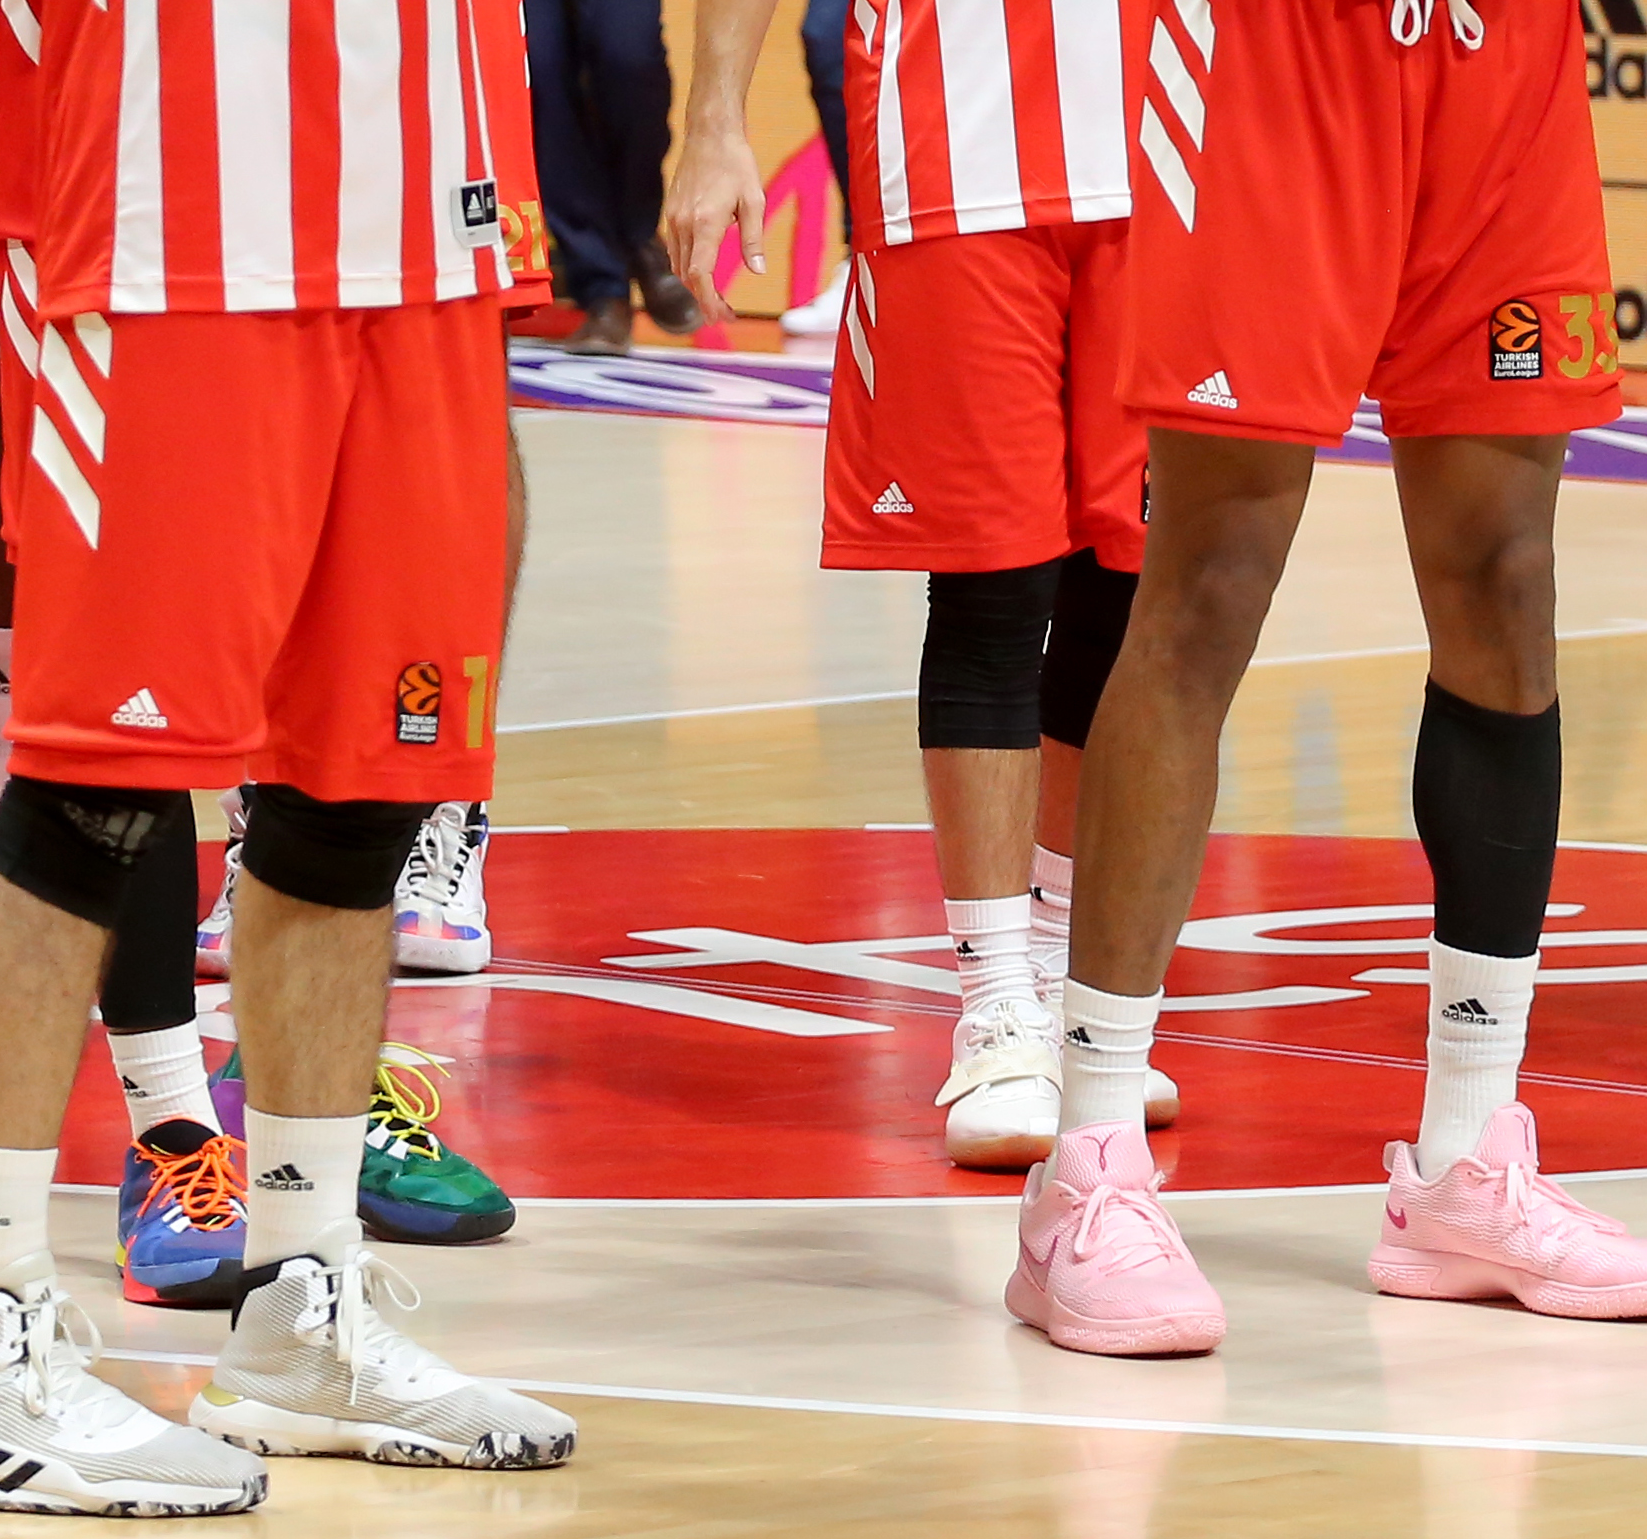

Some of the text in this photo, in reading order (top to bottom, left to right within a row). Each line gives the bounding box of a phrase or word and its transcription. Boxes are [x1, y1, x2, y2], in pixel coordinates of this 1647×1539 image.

[1557, 292, 1617, 380] 33
[1494, 353, 1540, 361] TURKISH
[1494, 361, 1540, 370] AIRLINES
[1494, 369, 1540, 378] EuroLeague
[1187, 390, 1238, 409] adidas
[872, 503, 914, 514] adidas
[463, 656, 496, 748] 1
[110, 711, 169, 729] adidas
[399, 714, 439, 724] TURKISH
[399, 723, 439, 732] AIRLINES
[1441, 1009, 1498, 1025] adidas
[254, 1178, 315, 1191] adidas
